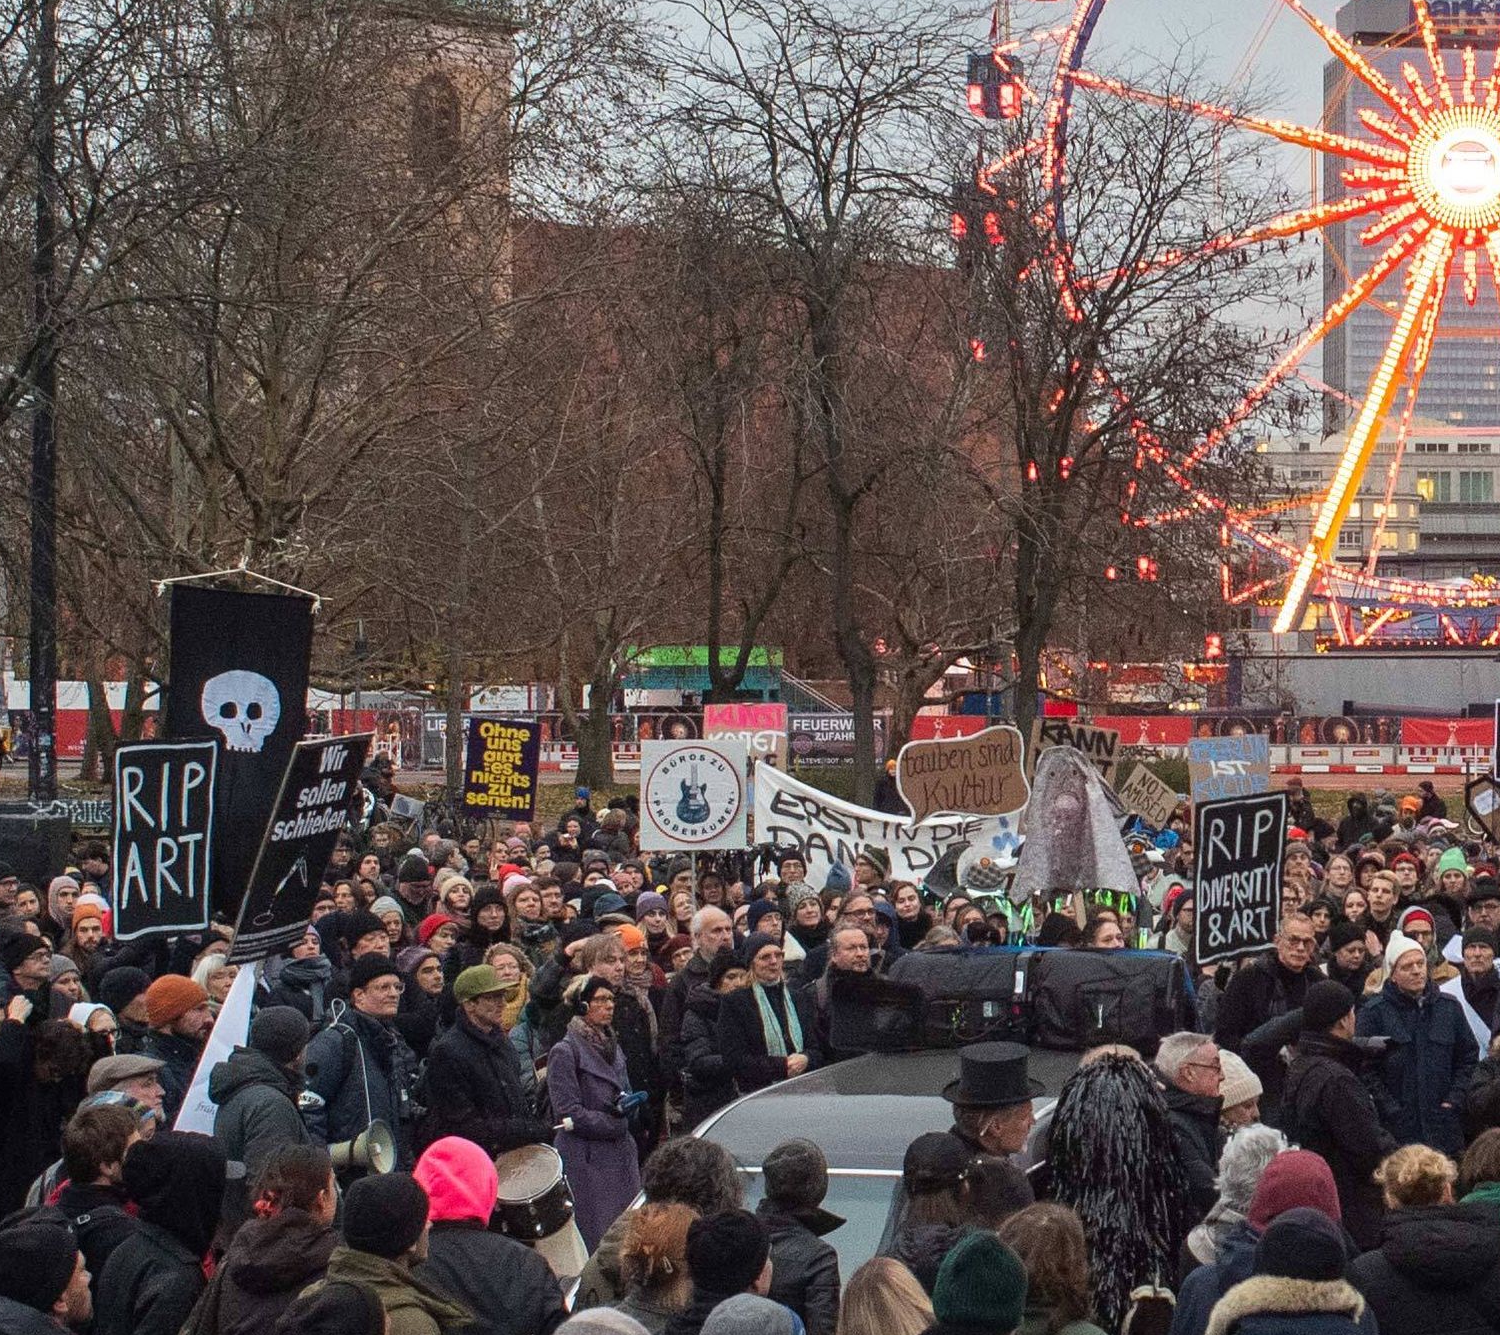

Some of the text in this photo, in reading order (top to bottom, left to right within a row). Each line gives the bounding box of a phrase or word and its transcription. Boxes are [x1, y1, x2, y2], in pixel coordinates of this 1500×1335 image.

[480, 721, 531, 742] Ohne
[486, 737, 522, 752] uns
[318, 745, 348, 773] Wir
[490, 760, 513, 775] es
[661, 752, 706, 776] BÜROS
[709, 756, 726, 773] ZU
[1210, 759, 1252, 779] IST
[122, 761, 206, 832] RIP
[297, 777, 347, 809] sollen
[488, 783, 512, 796] zu
[1138, 772, 1170, 802] NOT
[1121, 782, 1167, 824] AMUSED
[271, 808, 347, 842] schließen
[1208, 809, 1274, 869] RIP
[121, 833, 204, 910] ART
[1200, 863, 1276, 913] DIVERSITY
